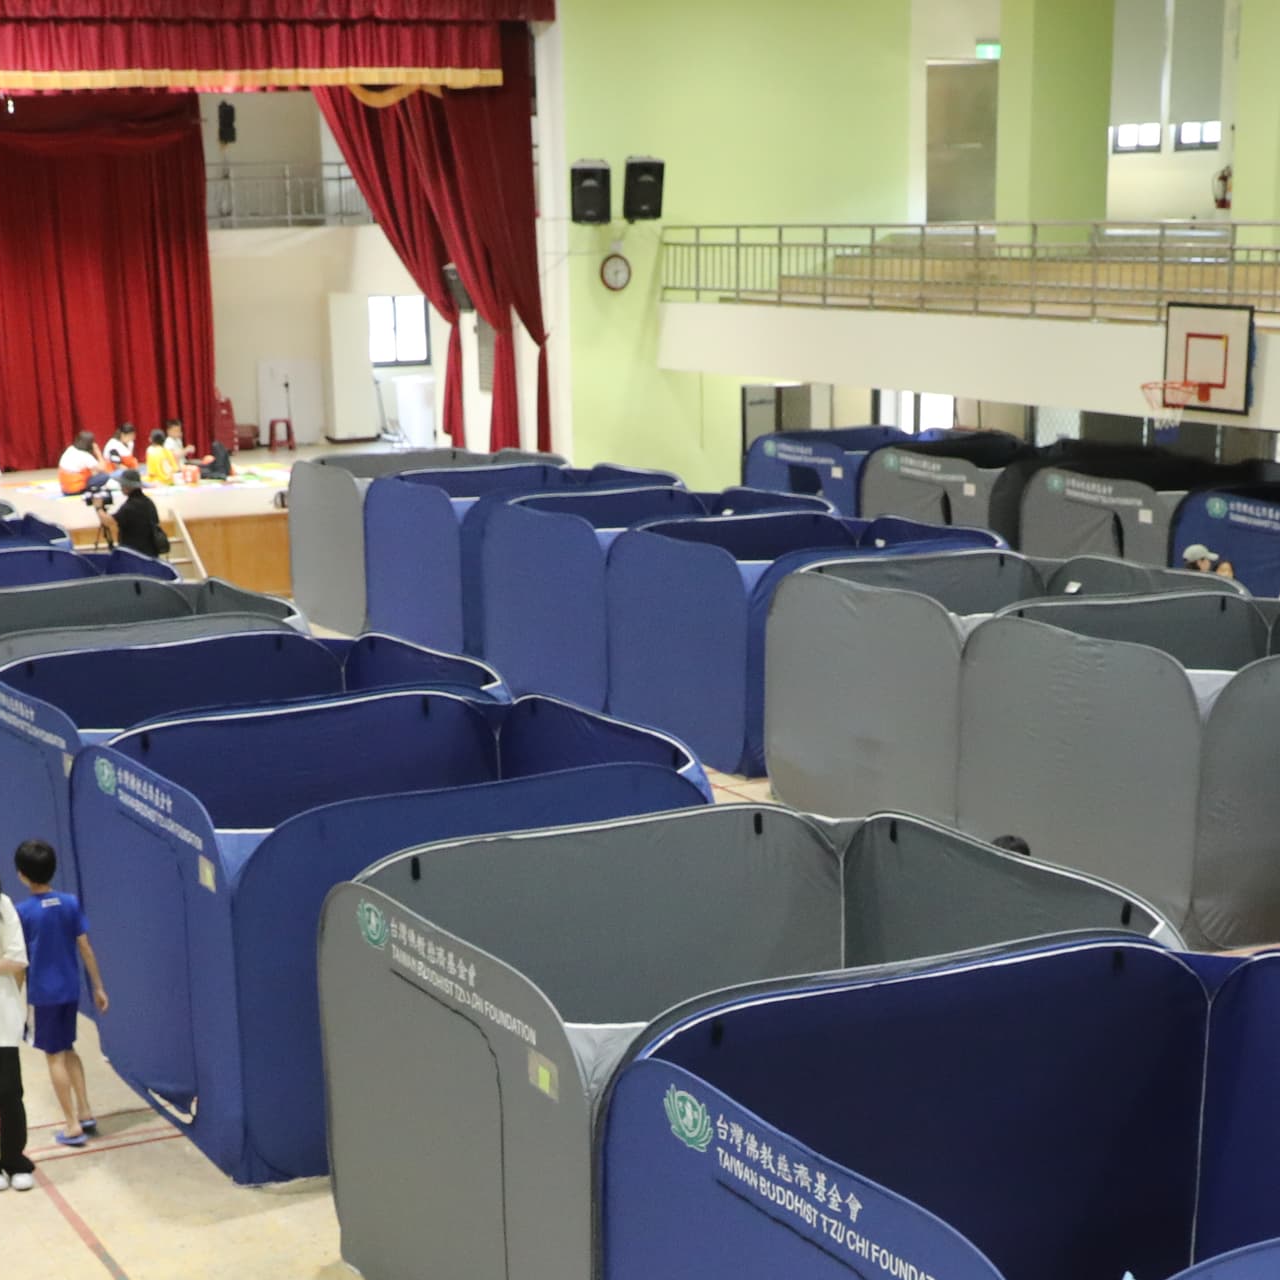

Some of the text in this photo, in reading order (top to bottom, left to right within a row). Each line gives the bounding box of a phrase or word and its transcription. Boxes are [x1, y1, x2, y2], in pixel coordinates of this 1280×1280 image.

[484, 1000, 536, 1045] FOUNDATION
[716, 1146, 758, 1189] TAIWAN
[759, 1176, 820, 1227] BUDDHIST
[820, 1212, 846, 1244] TZU
[846, 1229, 870, 1259] CHI
